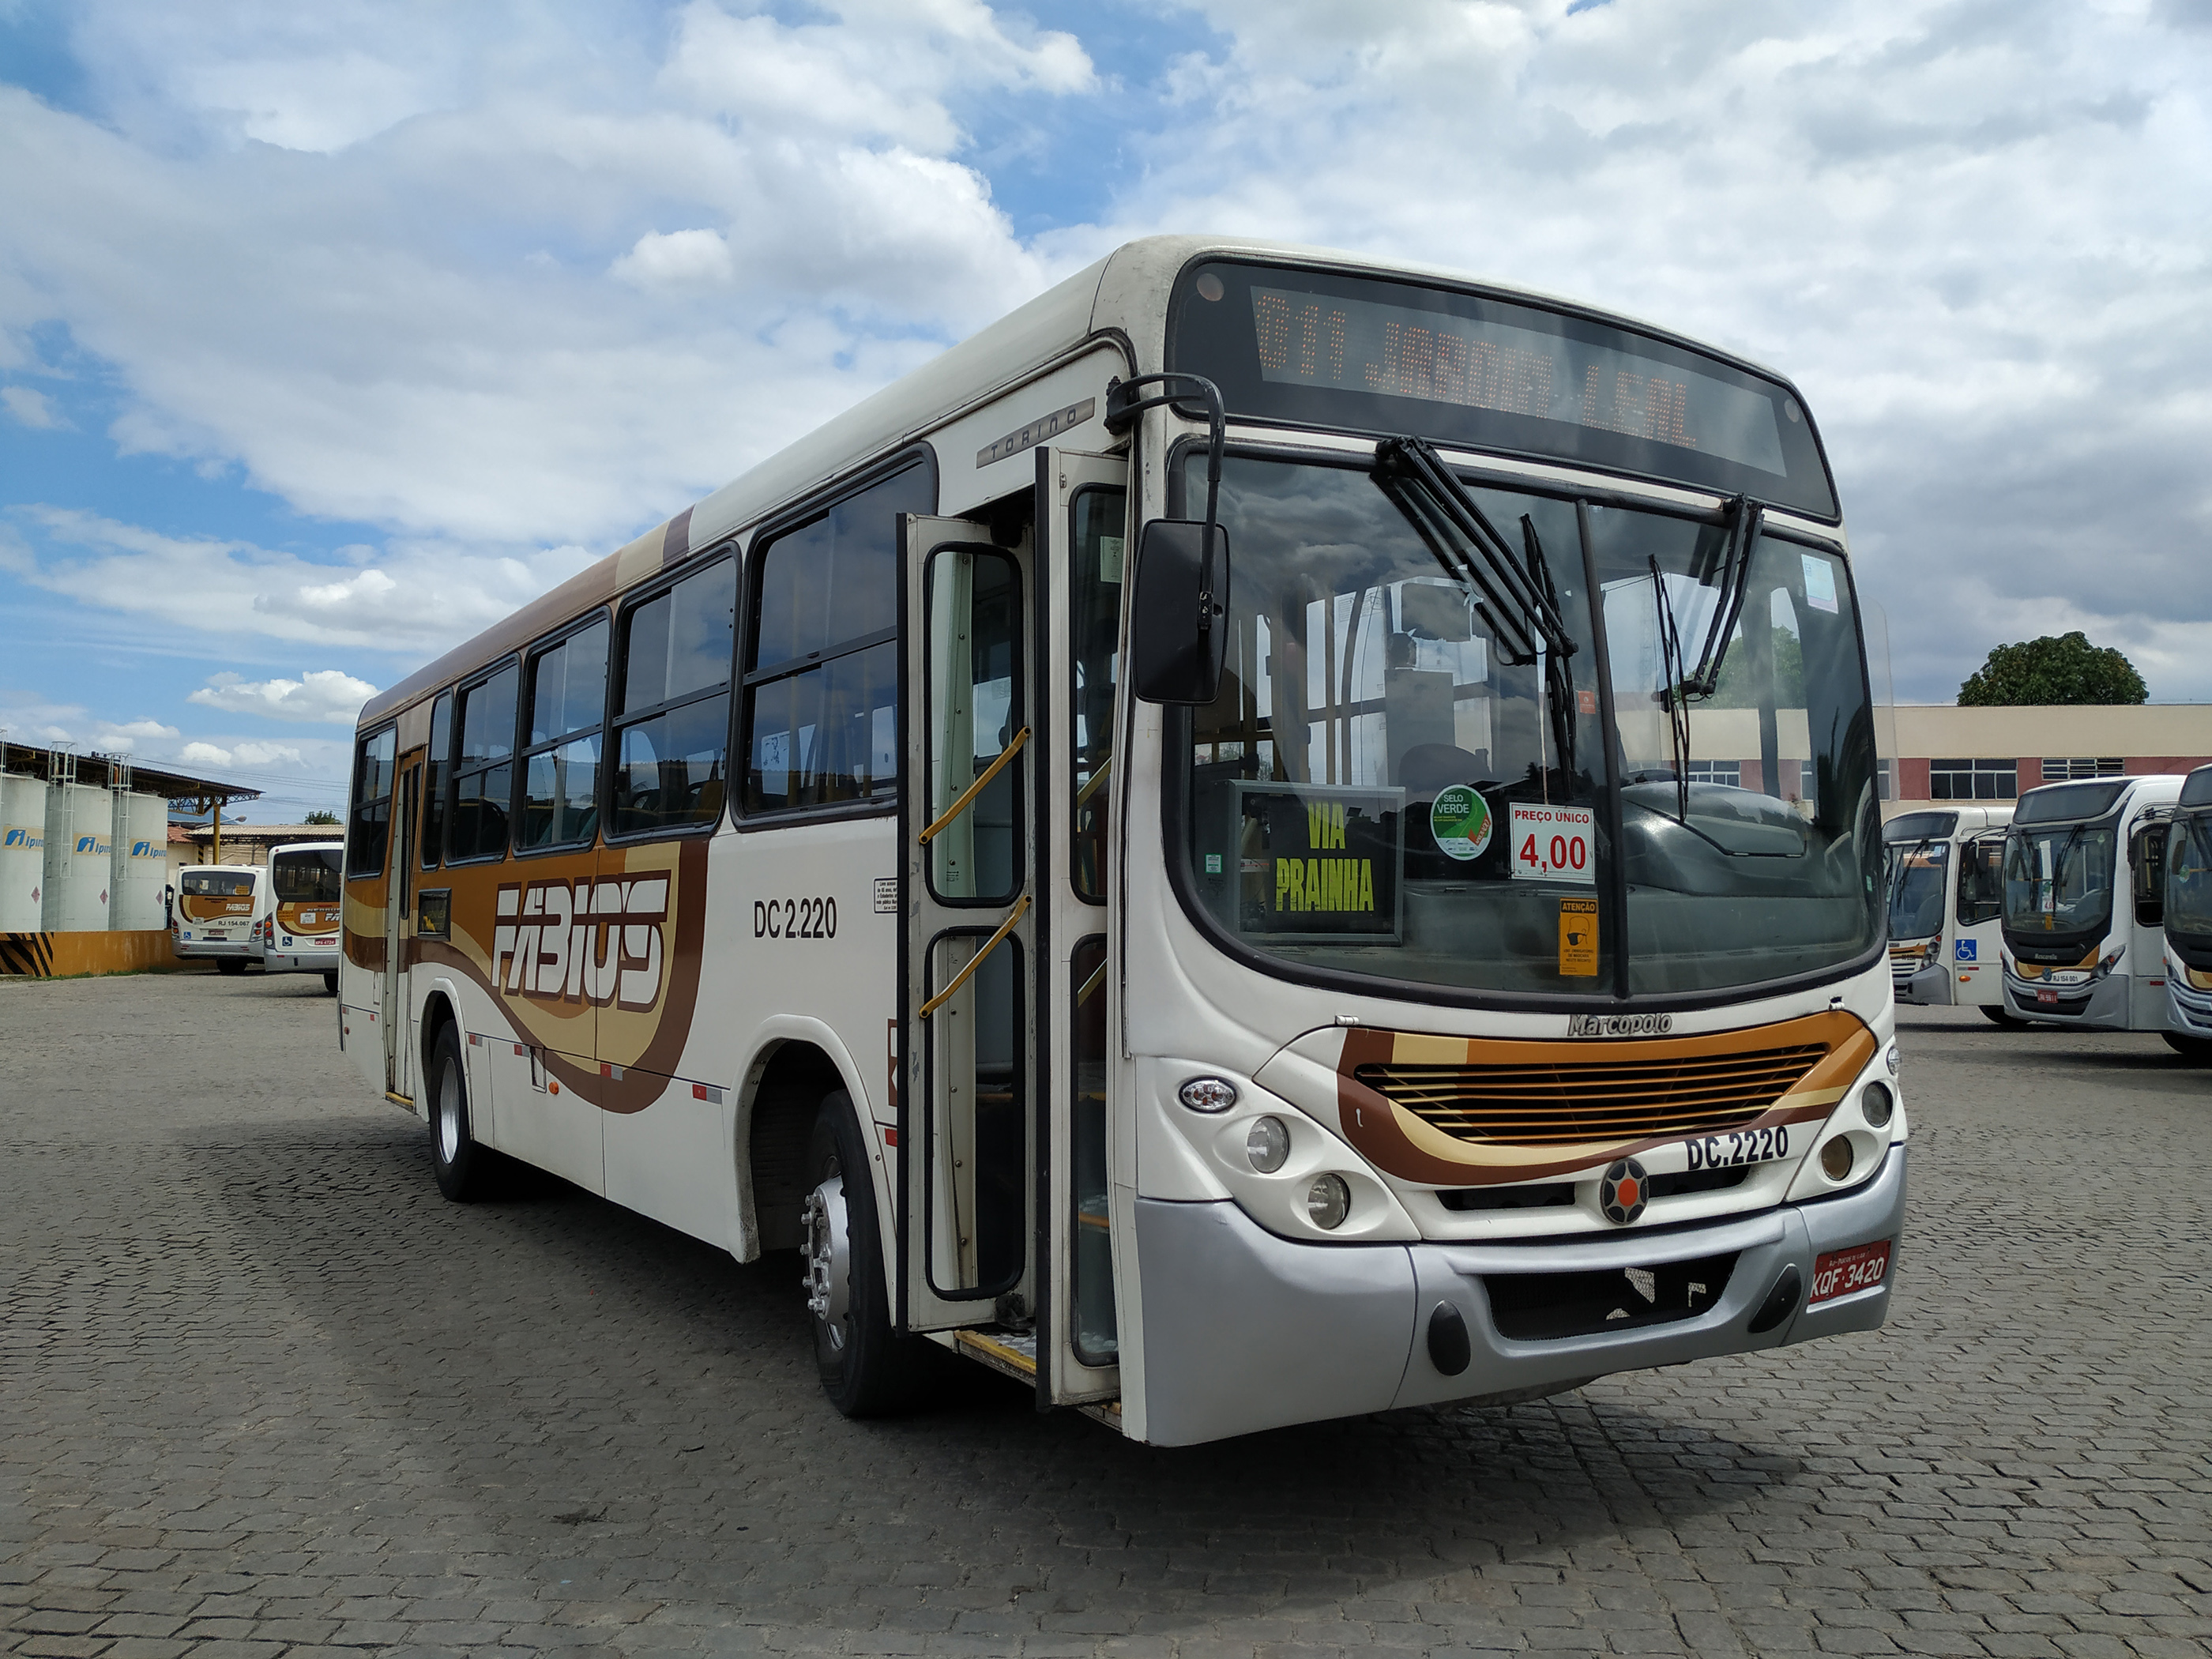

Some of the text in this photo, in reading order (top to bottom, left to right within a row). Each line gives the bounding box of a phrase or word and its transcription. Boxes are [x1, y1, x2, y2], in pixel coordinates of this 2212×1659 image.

[1582, 364, 1696, 446] LEAL
[991, 408, 1076, 459] TORINO
[1436, 803, 1469, 814] VERDE
[1443, 794, 1464, 803] SELO
[1514, 810, 1589, 824] PREÇO ÚNICO
[1307, 800, 1346, 849] VIA
[1520, 833, 1586, 873] 4,00
[1276, 858, 1375, 911] PRAINHA
[754, 896, 837, 939] DC 2.220
[1562, 901, 1596, 913] ATENÇÃO
[1567, 1013, 1672, 1036] Marcopolo
[1684, 1126, 1789, 1171] DC.2220
